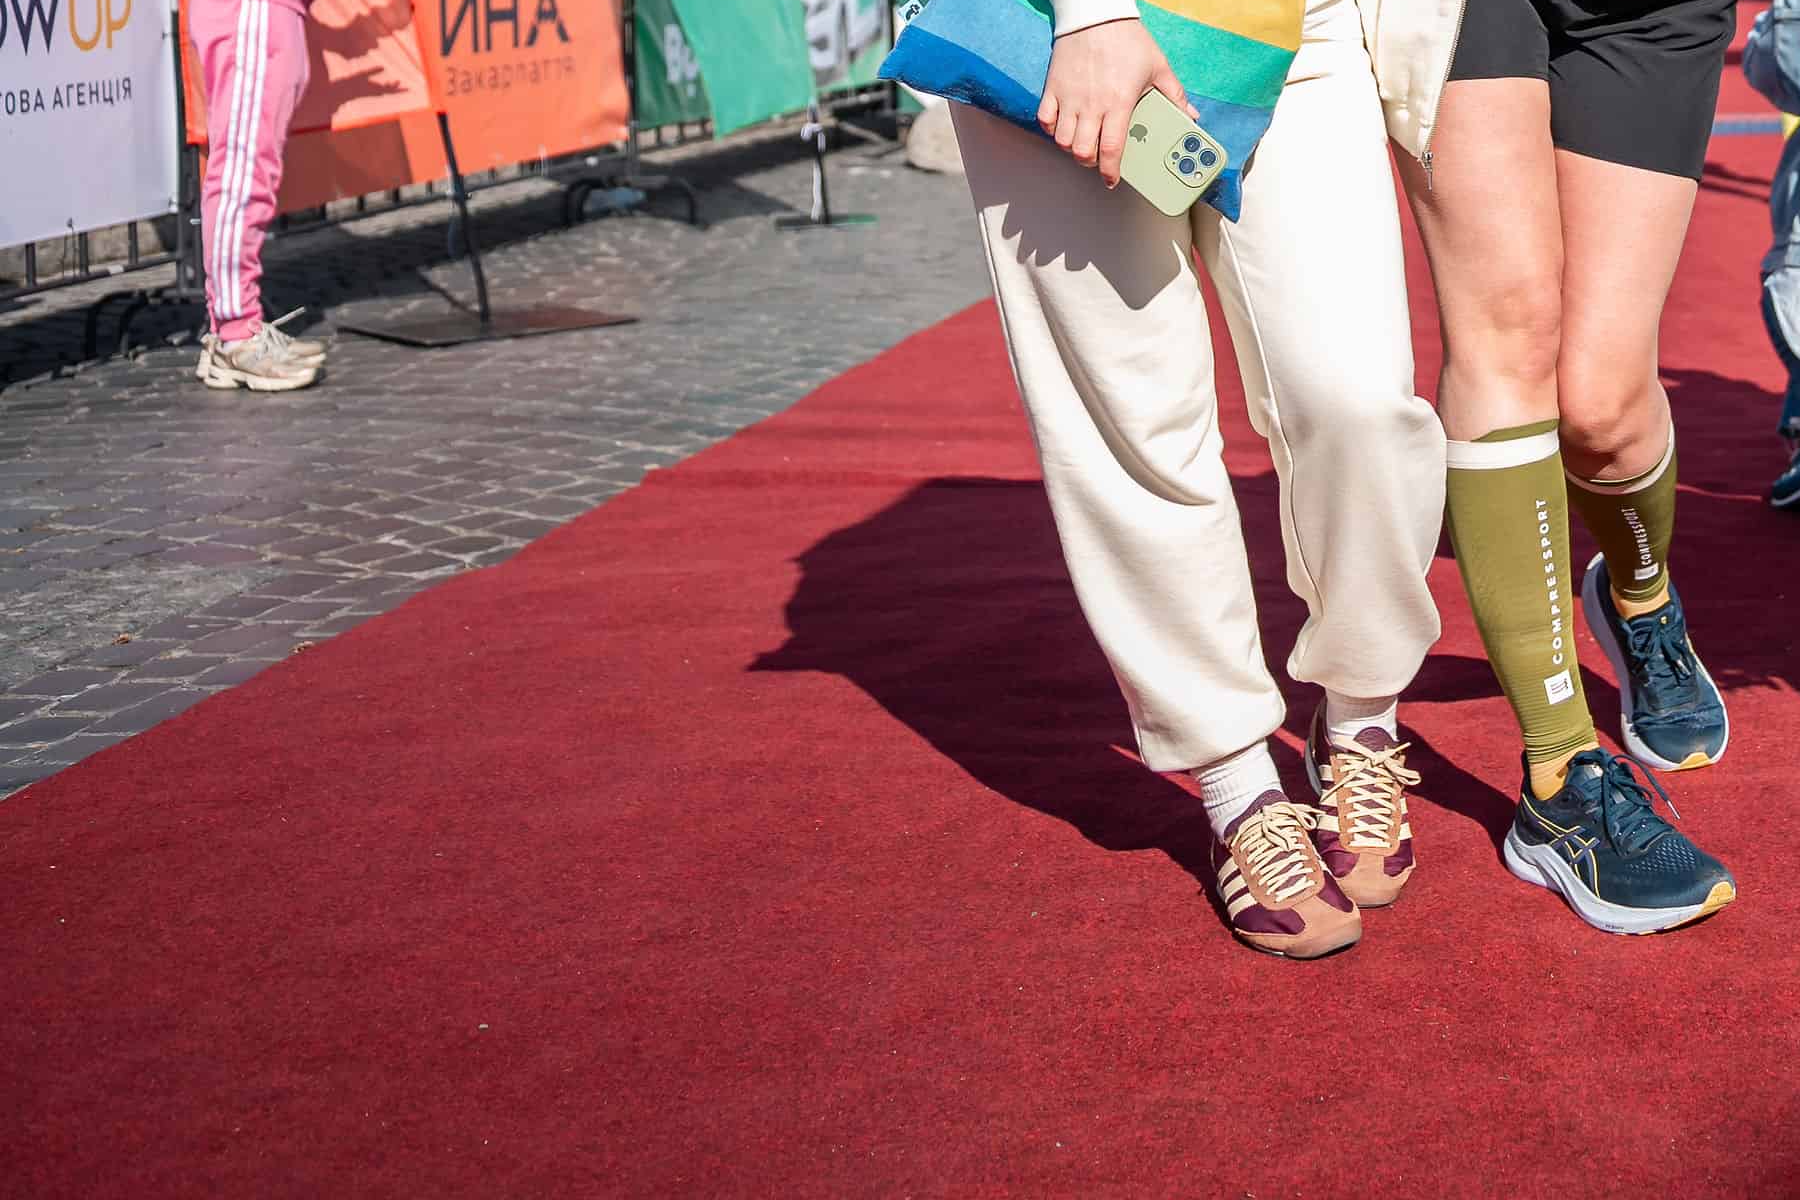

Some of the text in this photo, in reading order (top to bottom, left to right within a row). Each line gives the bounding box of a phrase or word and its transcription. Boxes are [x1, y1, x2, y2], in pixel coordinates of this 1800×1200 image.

[0, 76, 133, 117] ОВА АГЕНЦІЯ
[1619, 506, 1655, 567] COMPRESSPORT
[1534, 497, 1565, 666] COMPRESSPORT
